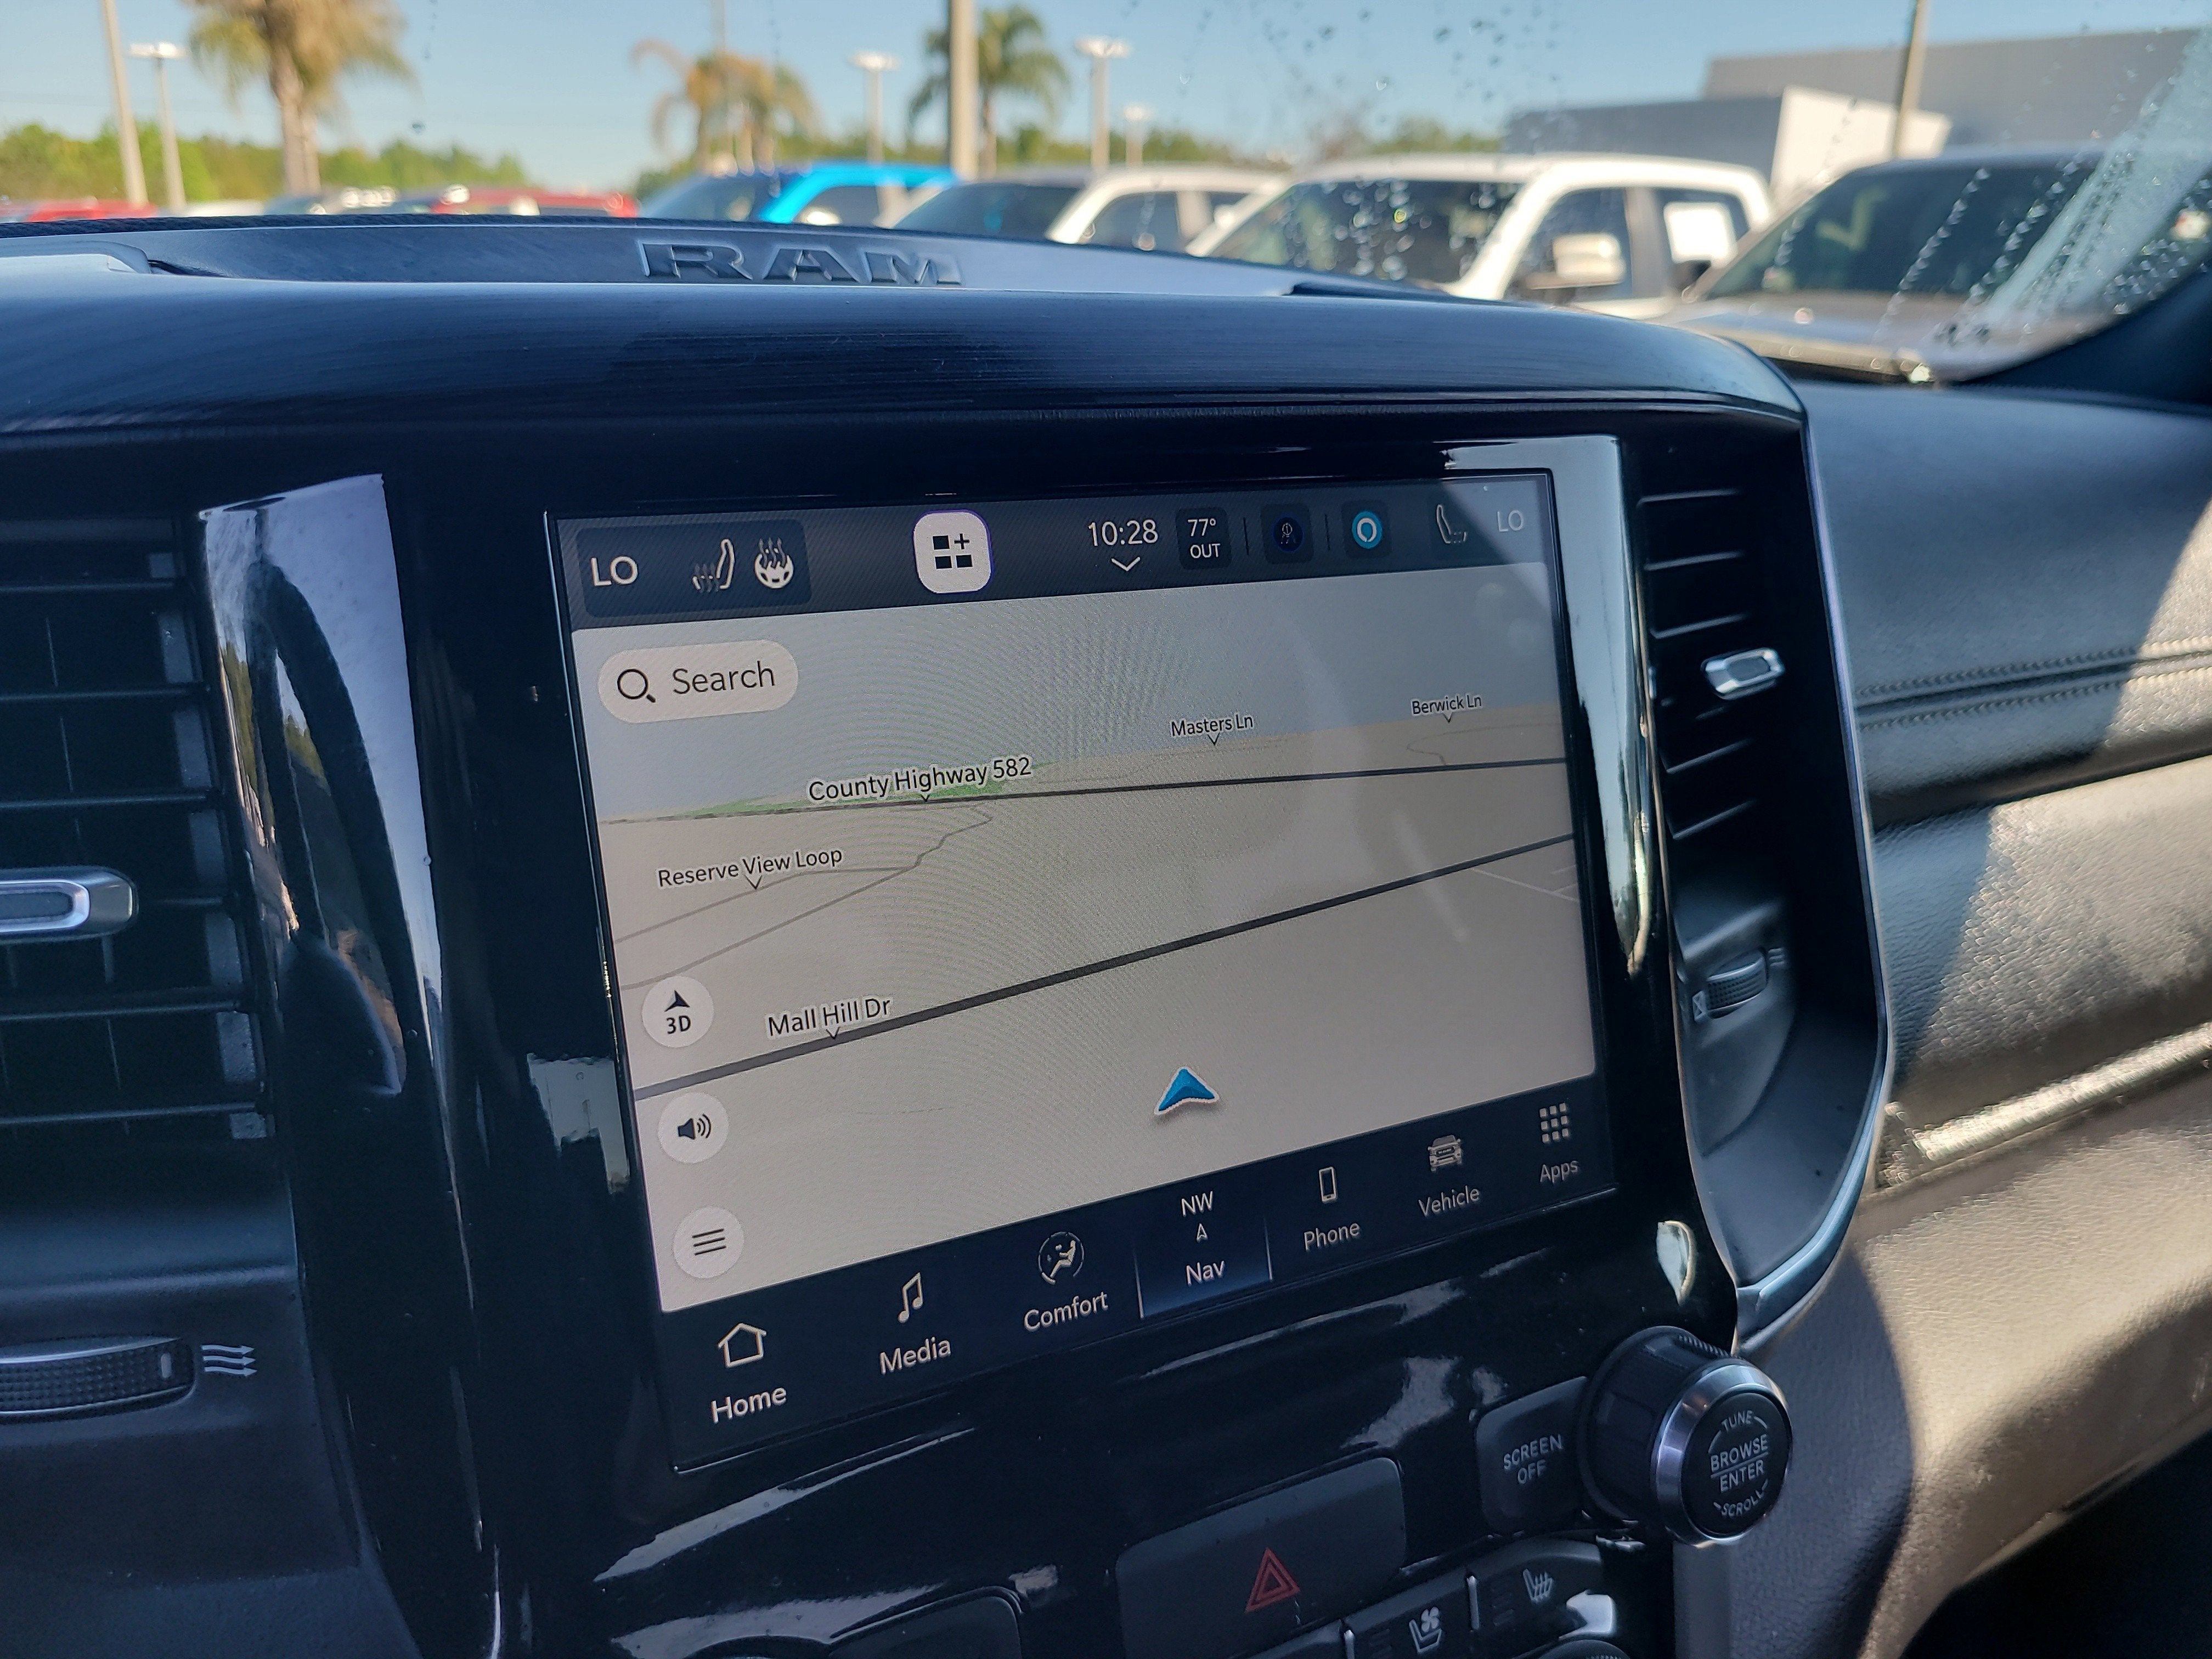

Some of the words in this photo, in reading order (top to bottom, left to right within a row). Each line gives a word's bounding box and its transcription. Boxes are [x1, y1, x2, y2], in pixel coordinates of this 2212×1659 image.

[637, 239, 962, 285] RAM
[1087, 519, 1159, 546] 10:28
[1187, 518, 1216, 537] 77°
[1497, 510, 1524, 532] LO
[1190, 544, 1220, 559] OUT
[589, 555, 639, 587] LO
[672, 661, 775, 695] Search
[1412, 694, 1464, 714] Berwick
[1465, 693, 1482, 709] Ln
[1170, 717, 1233, 738] Masters
[1235, 714, 1254, 731] Ln
[809, 775, 889, 802] County
[894, 763, 988, 794] Highway
[993, 757, 1032, 778] 582
[658, 865, 739, 887] Reserve
[742, 855, 791, 876] View
[795, 849, 843, 872] Loop
[666, 1015, 692, 1035] 3D
[768, 1007, 817, 1037] Mall
[822, 1001, 860, 1026] Hill
[866, 997, 891, 1019] Dr
[1539, 1158, 1579, 1184] Apps
[1181, 1192, 1214, 1217] NW
[1418, 1186, 1480, 1216] Vehicle
[1304, 1220, 1361, 1251] Phone
[1185, 1259, 1226, 1285] Nav
[1024, 1291, 1109, 1331] Comfort
[879, 1336, 951, 1375] Media
[711, 1385, 787, 1424] Home
[1722, 1409, 1753, 1432] TUNE
[1503, 1434, 1564, 1471] SCREEN
[1711, 1434, 1769, 1472] BROWSE
[1517, 1460, 1547, 1485] OFF
[1719, 1460, 1765, 1492] ENTER
[1721, 1491, 1764, 1517] SCROLL
